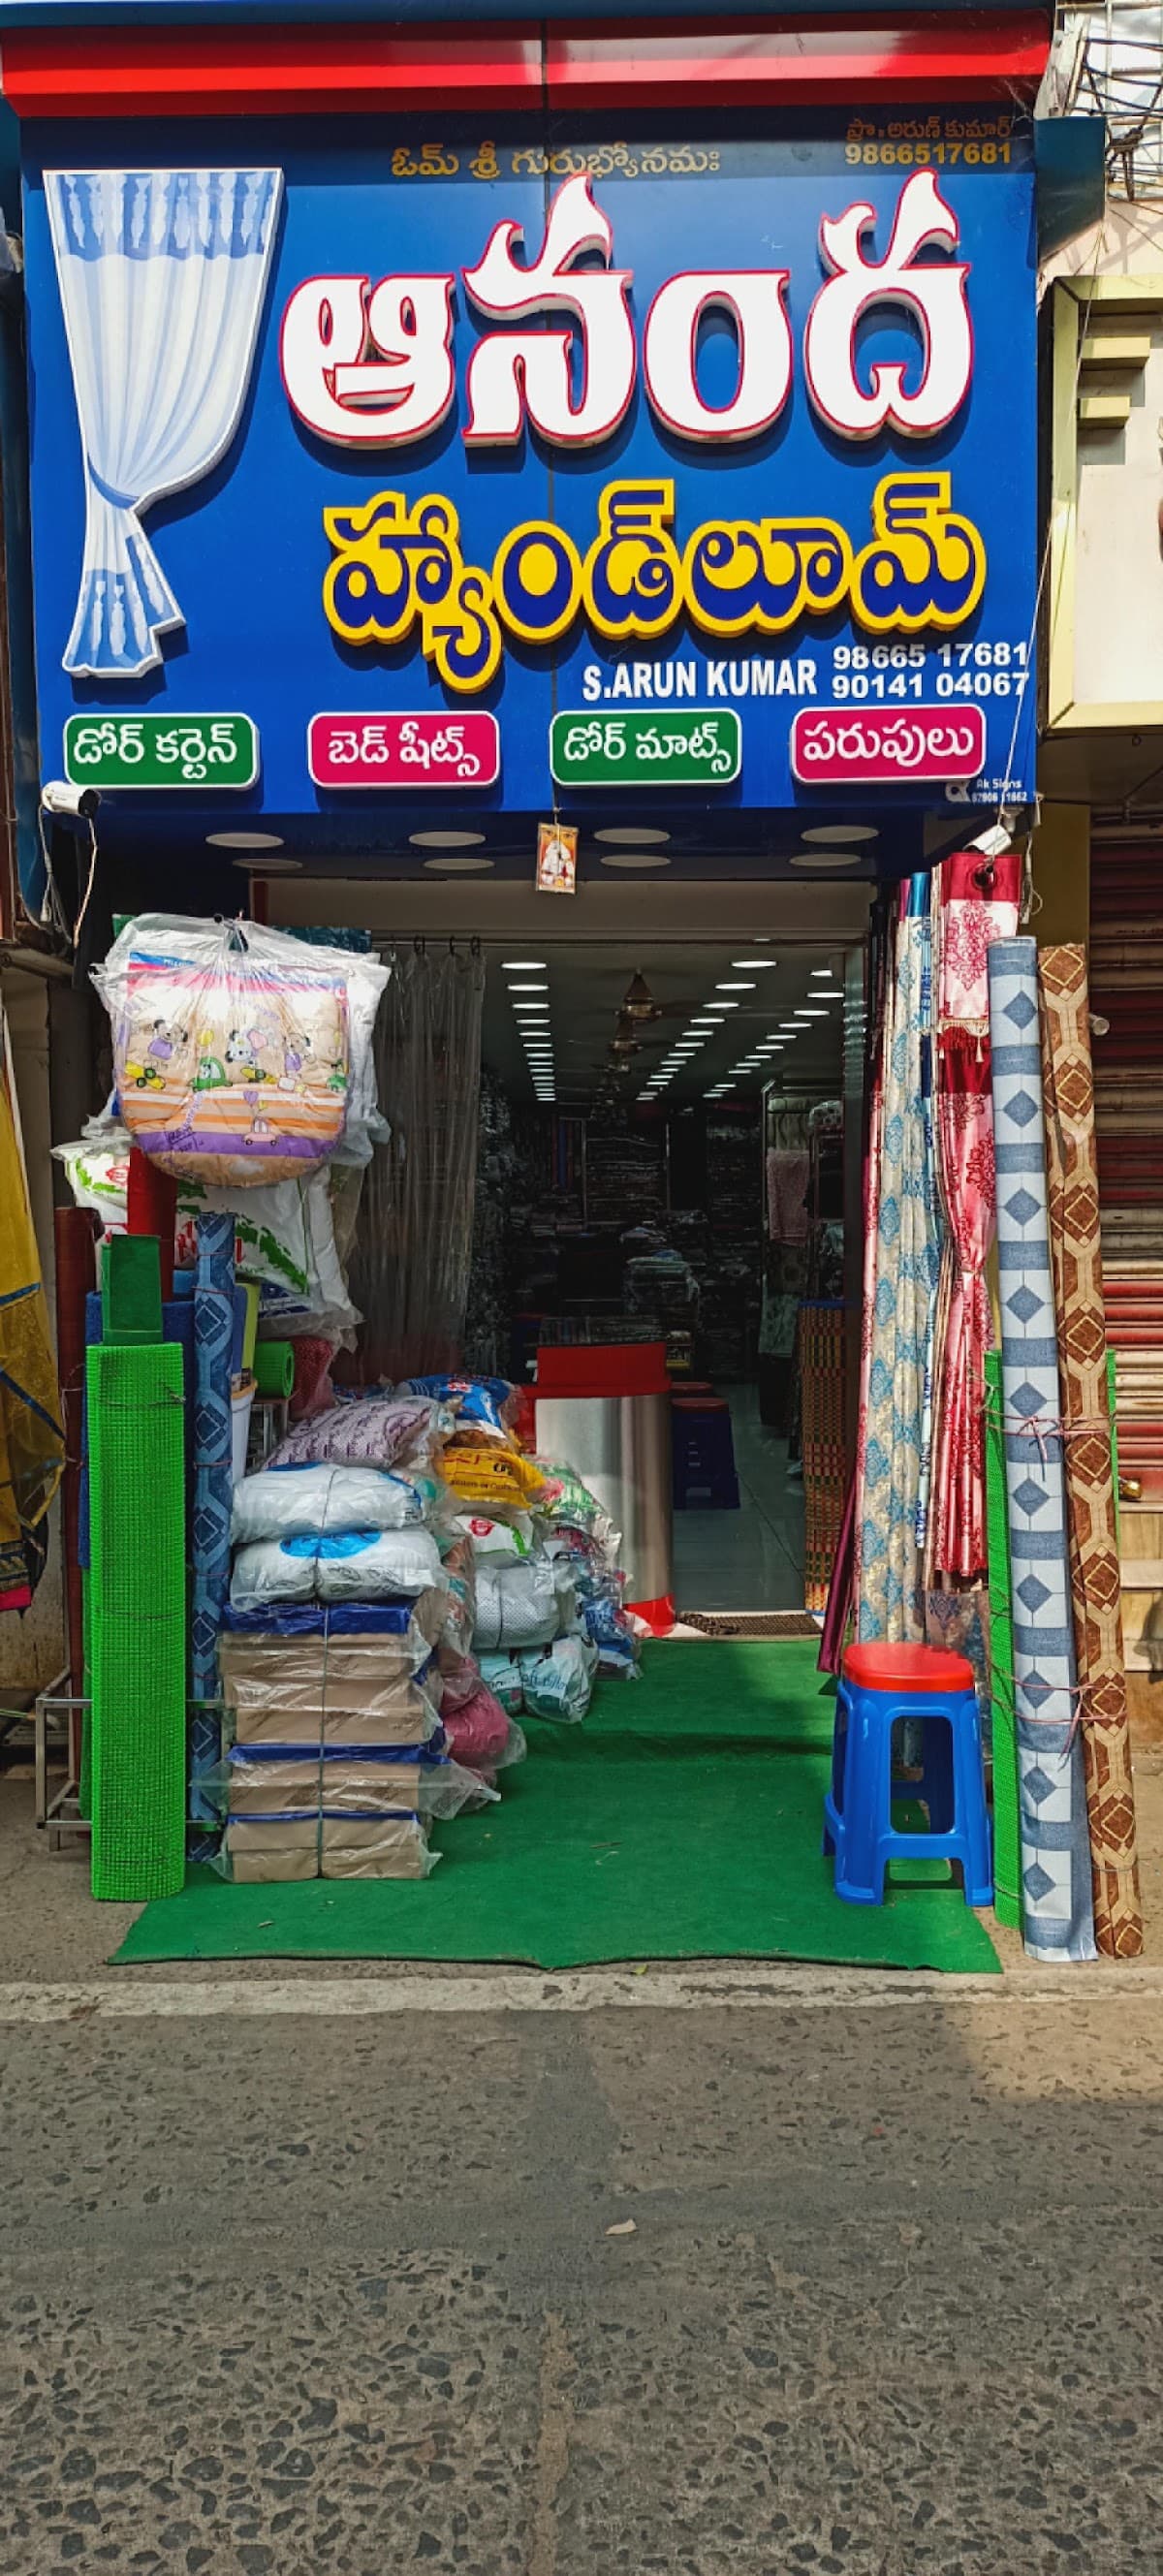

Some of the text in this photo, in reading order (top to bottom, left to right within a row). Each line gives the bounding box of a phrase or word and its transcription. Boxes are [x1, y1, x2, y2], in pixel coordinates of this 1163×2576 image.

[944, 115, 1012, 139] కుమార్
[391, 142, 459, 176] ఓమ్
[468, 140, 502, 179] శ్రీ
[845, 142, 1010, 165] 9866517681
[278, 168, 974, 447] ఆనంద
[832, 642, 1028, 670] 98665 17681
[582, 659, 817, 701] S.ARUN KUMAR
[832, 672, 1029, 699] 90141 04067
[73, 722, 145, 765] డోర్
[328, 720, 482, 777] బెడ్ షీట్స్
[563, 721, 733, 773] డోర్ మాట్స్
[802, 718, 975, 767] పరుపులు
